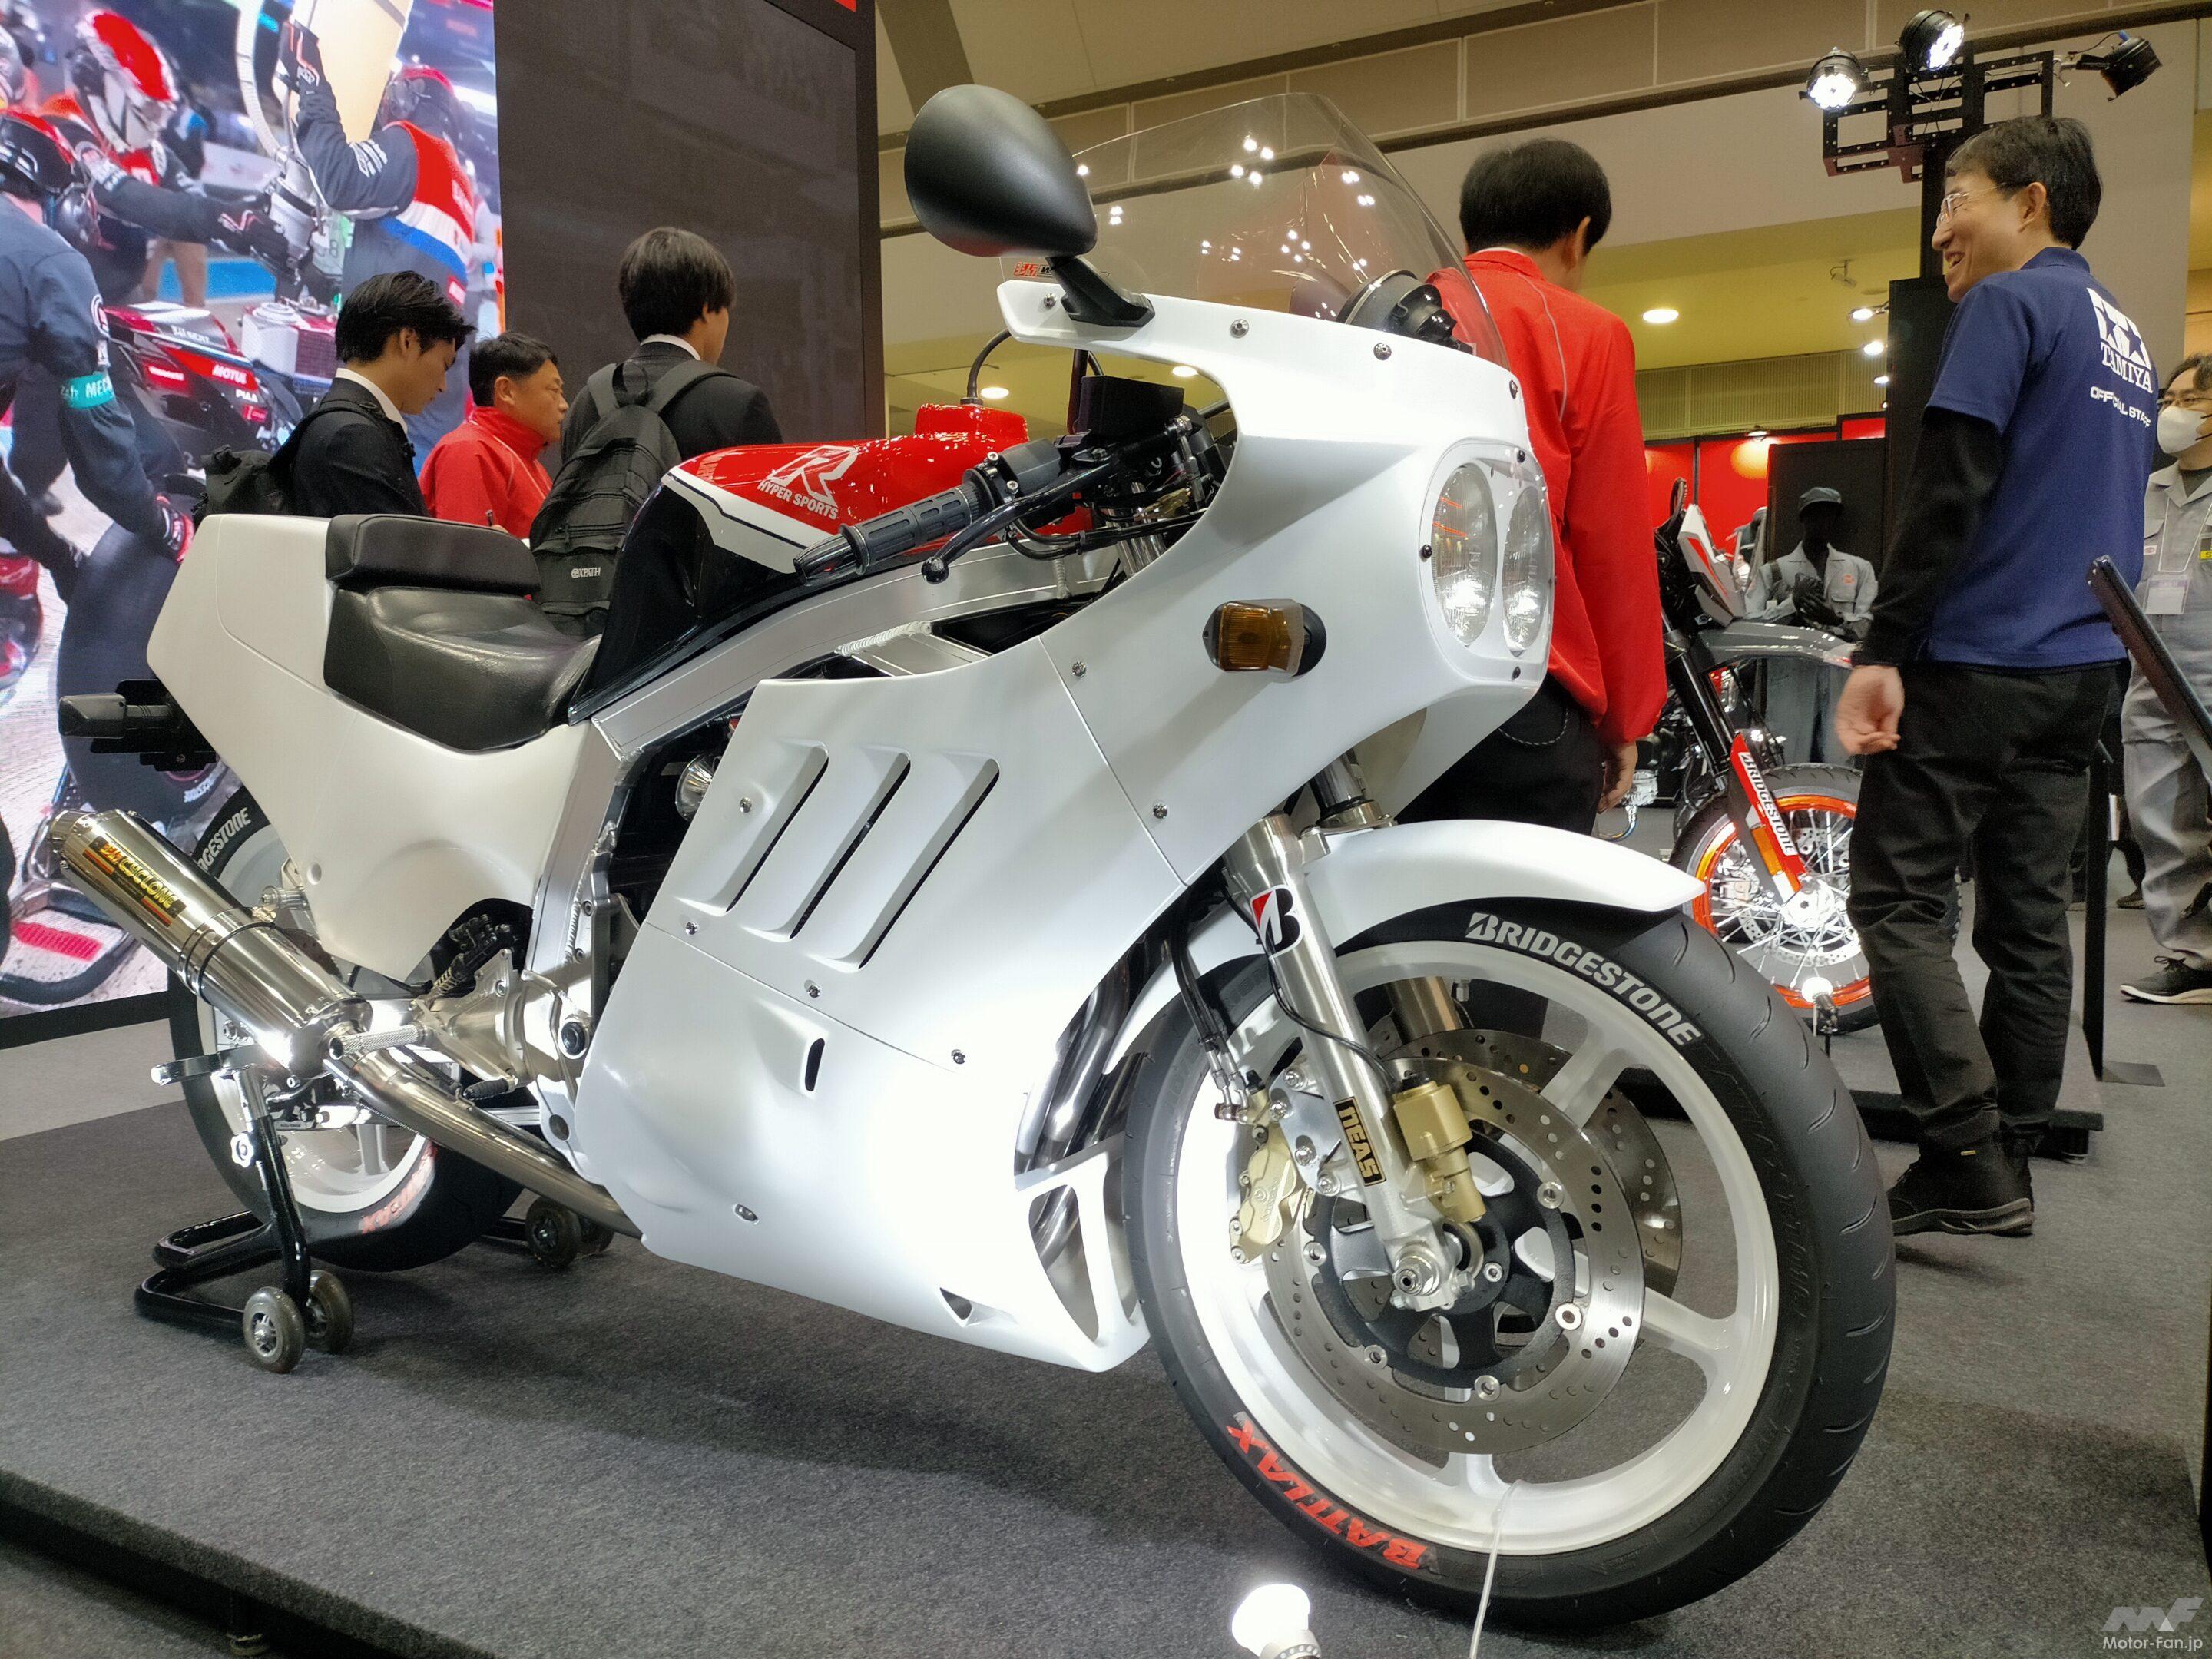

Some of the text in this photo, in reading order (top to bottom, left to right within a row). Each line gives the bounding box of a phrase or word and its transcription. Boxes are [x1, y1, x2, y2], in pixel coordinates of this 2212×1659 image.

[211, 364, 247, 385] MOTUL
[2100, 341, 2154, 394] TAMIYA
[235, 389, 259, 403] PIAA
[2090, 386, 2128, 416] OFFICIAL
[757, 479, 839, 521] HYPER SPORTS
[1739, 753, 1796, 854] BRIDGESTONE
[118, 856, 180, 909] CYCLONE
[1465, 912, 1702, 1046] BRIDGESTONE
[1225, 1419, 1427, 1570] BATTLAX
